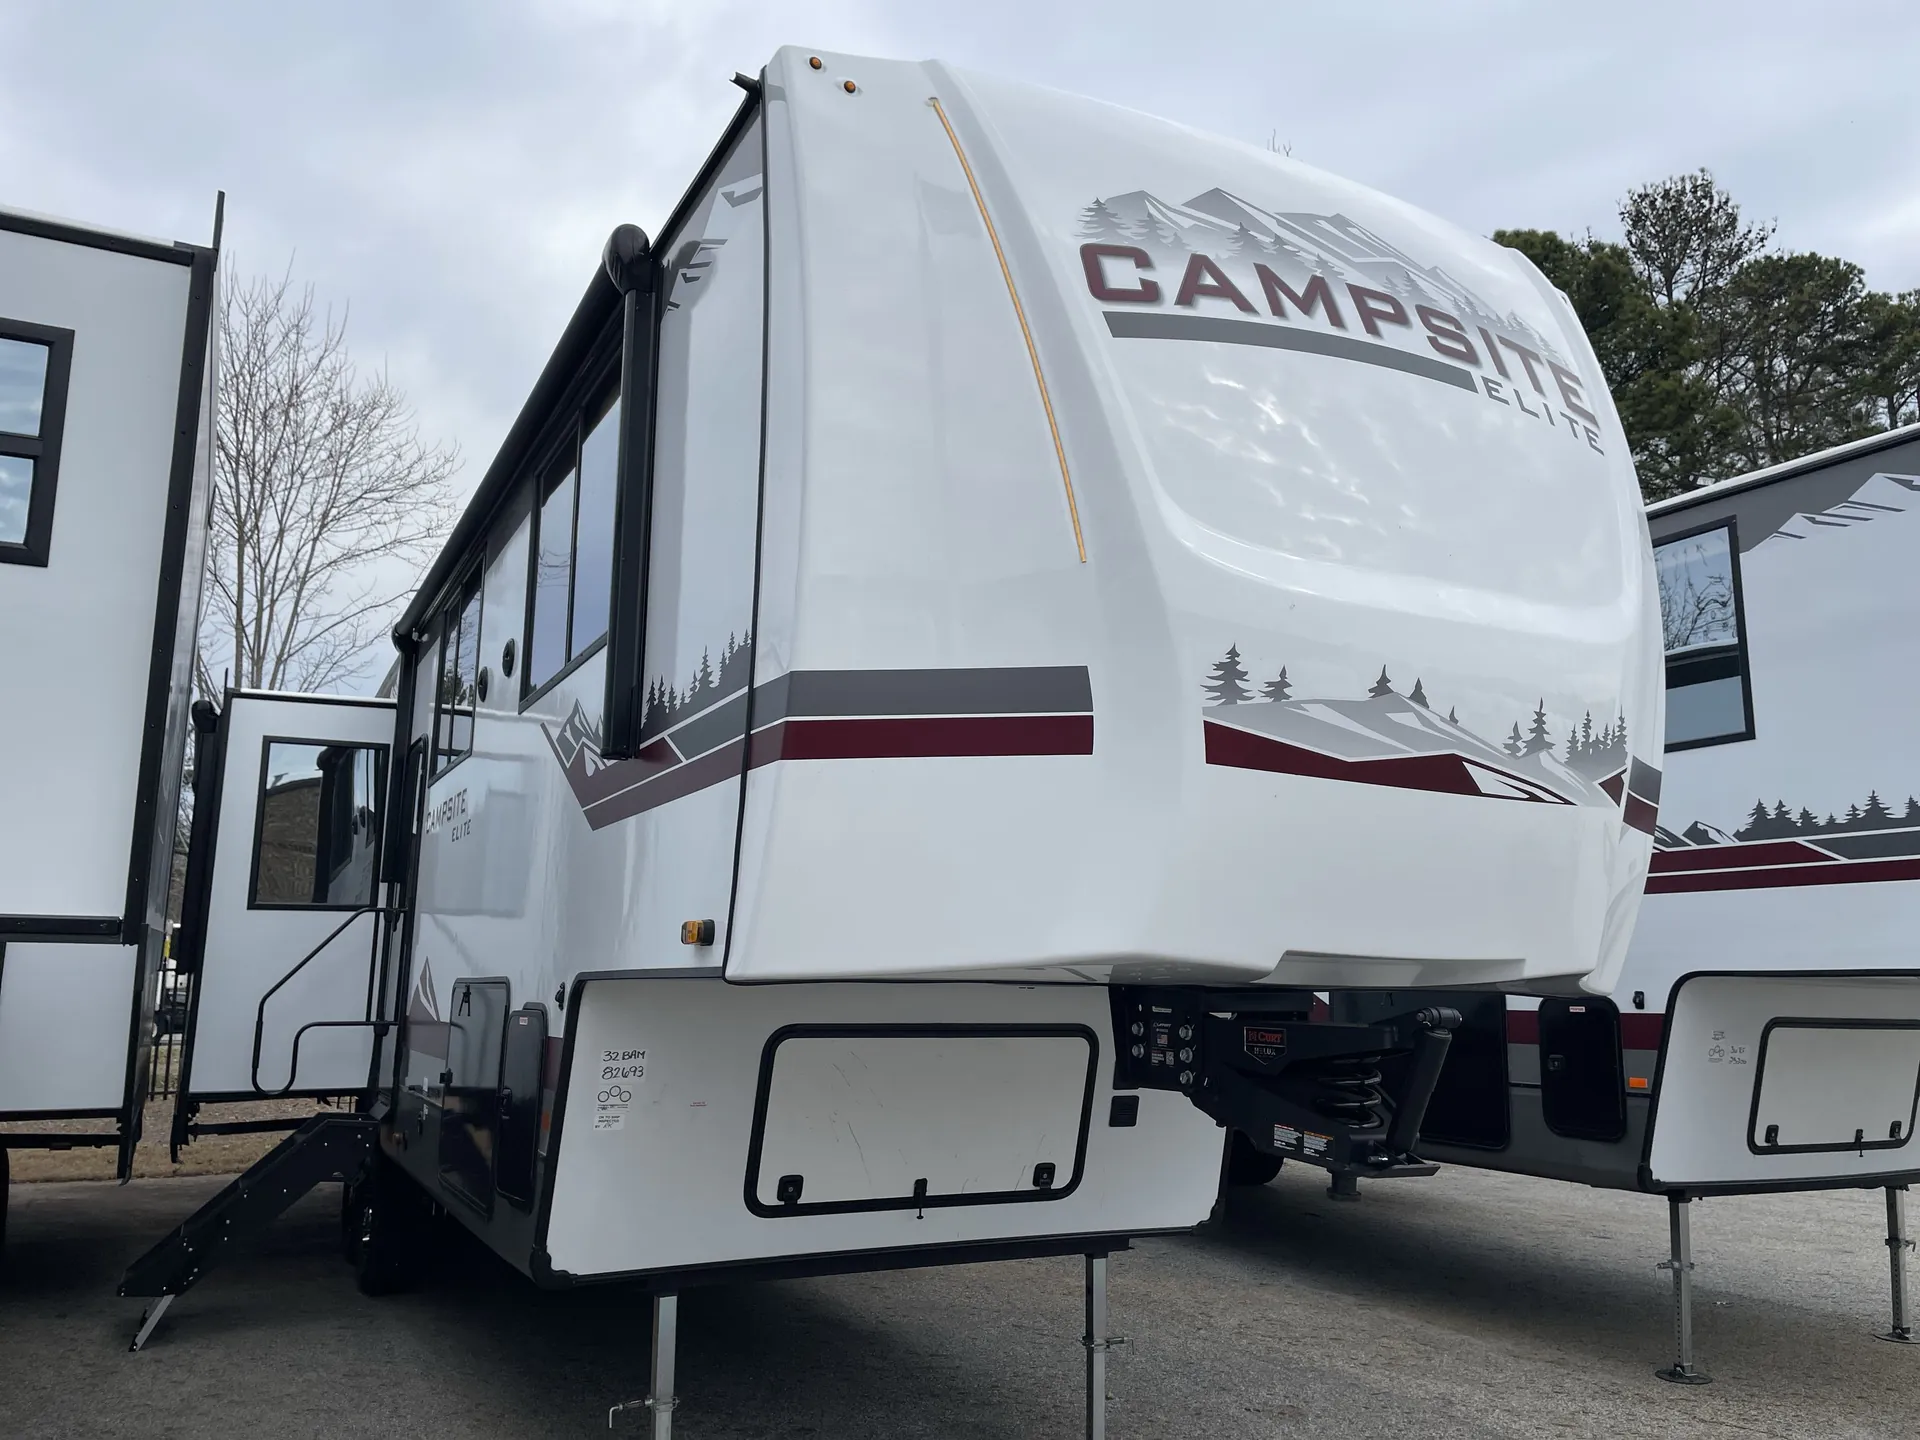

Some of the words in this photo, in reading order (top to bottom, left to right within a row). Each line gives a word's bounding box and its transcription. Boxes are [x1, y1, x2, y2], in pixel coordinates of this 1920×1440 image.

[1079, 242, 1599, 430] CAMPSITE
[1480, 375, 1605, 456] ELITE
[426, 788, 467, 834] CAMPSITE
[452, 819, 471, 842] ELITE
[1258, 1031, 1282, 1043] CURT
[602, 1065, 644, 1080] 82693
